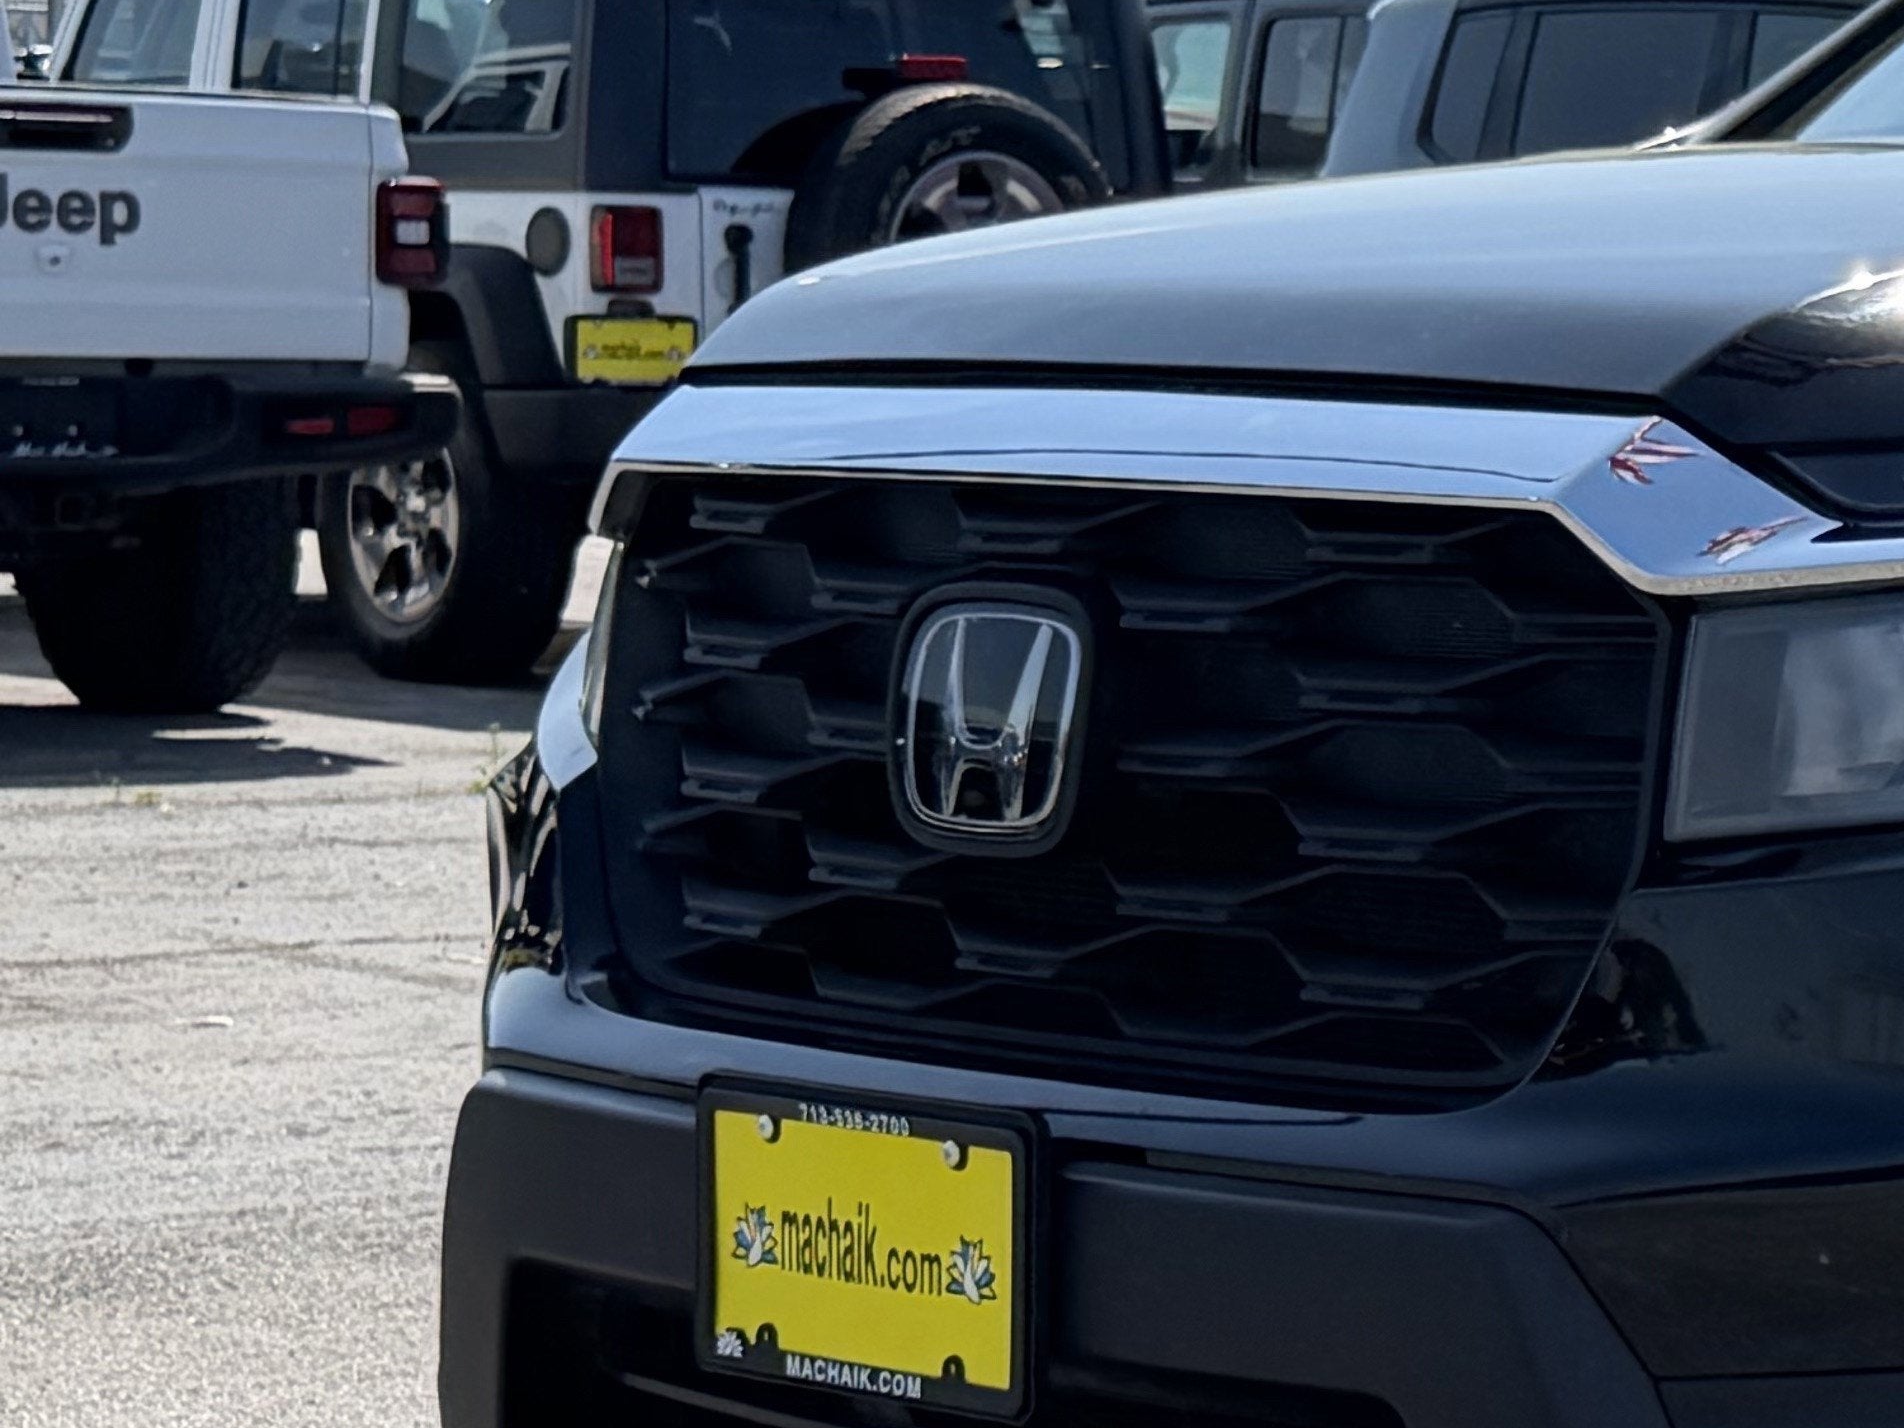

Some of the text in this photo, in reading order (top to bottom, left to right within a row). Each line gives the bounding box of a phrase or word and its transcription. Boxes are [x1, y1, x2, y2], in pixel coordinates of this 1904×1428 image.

[0, 172, 141, 246] eep
[781, 1196, 942, 1296] machaik.com
[785, 1354, 922, 1400] MACHAIK.COM
